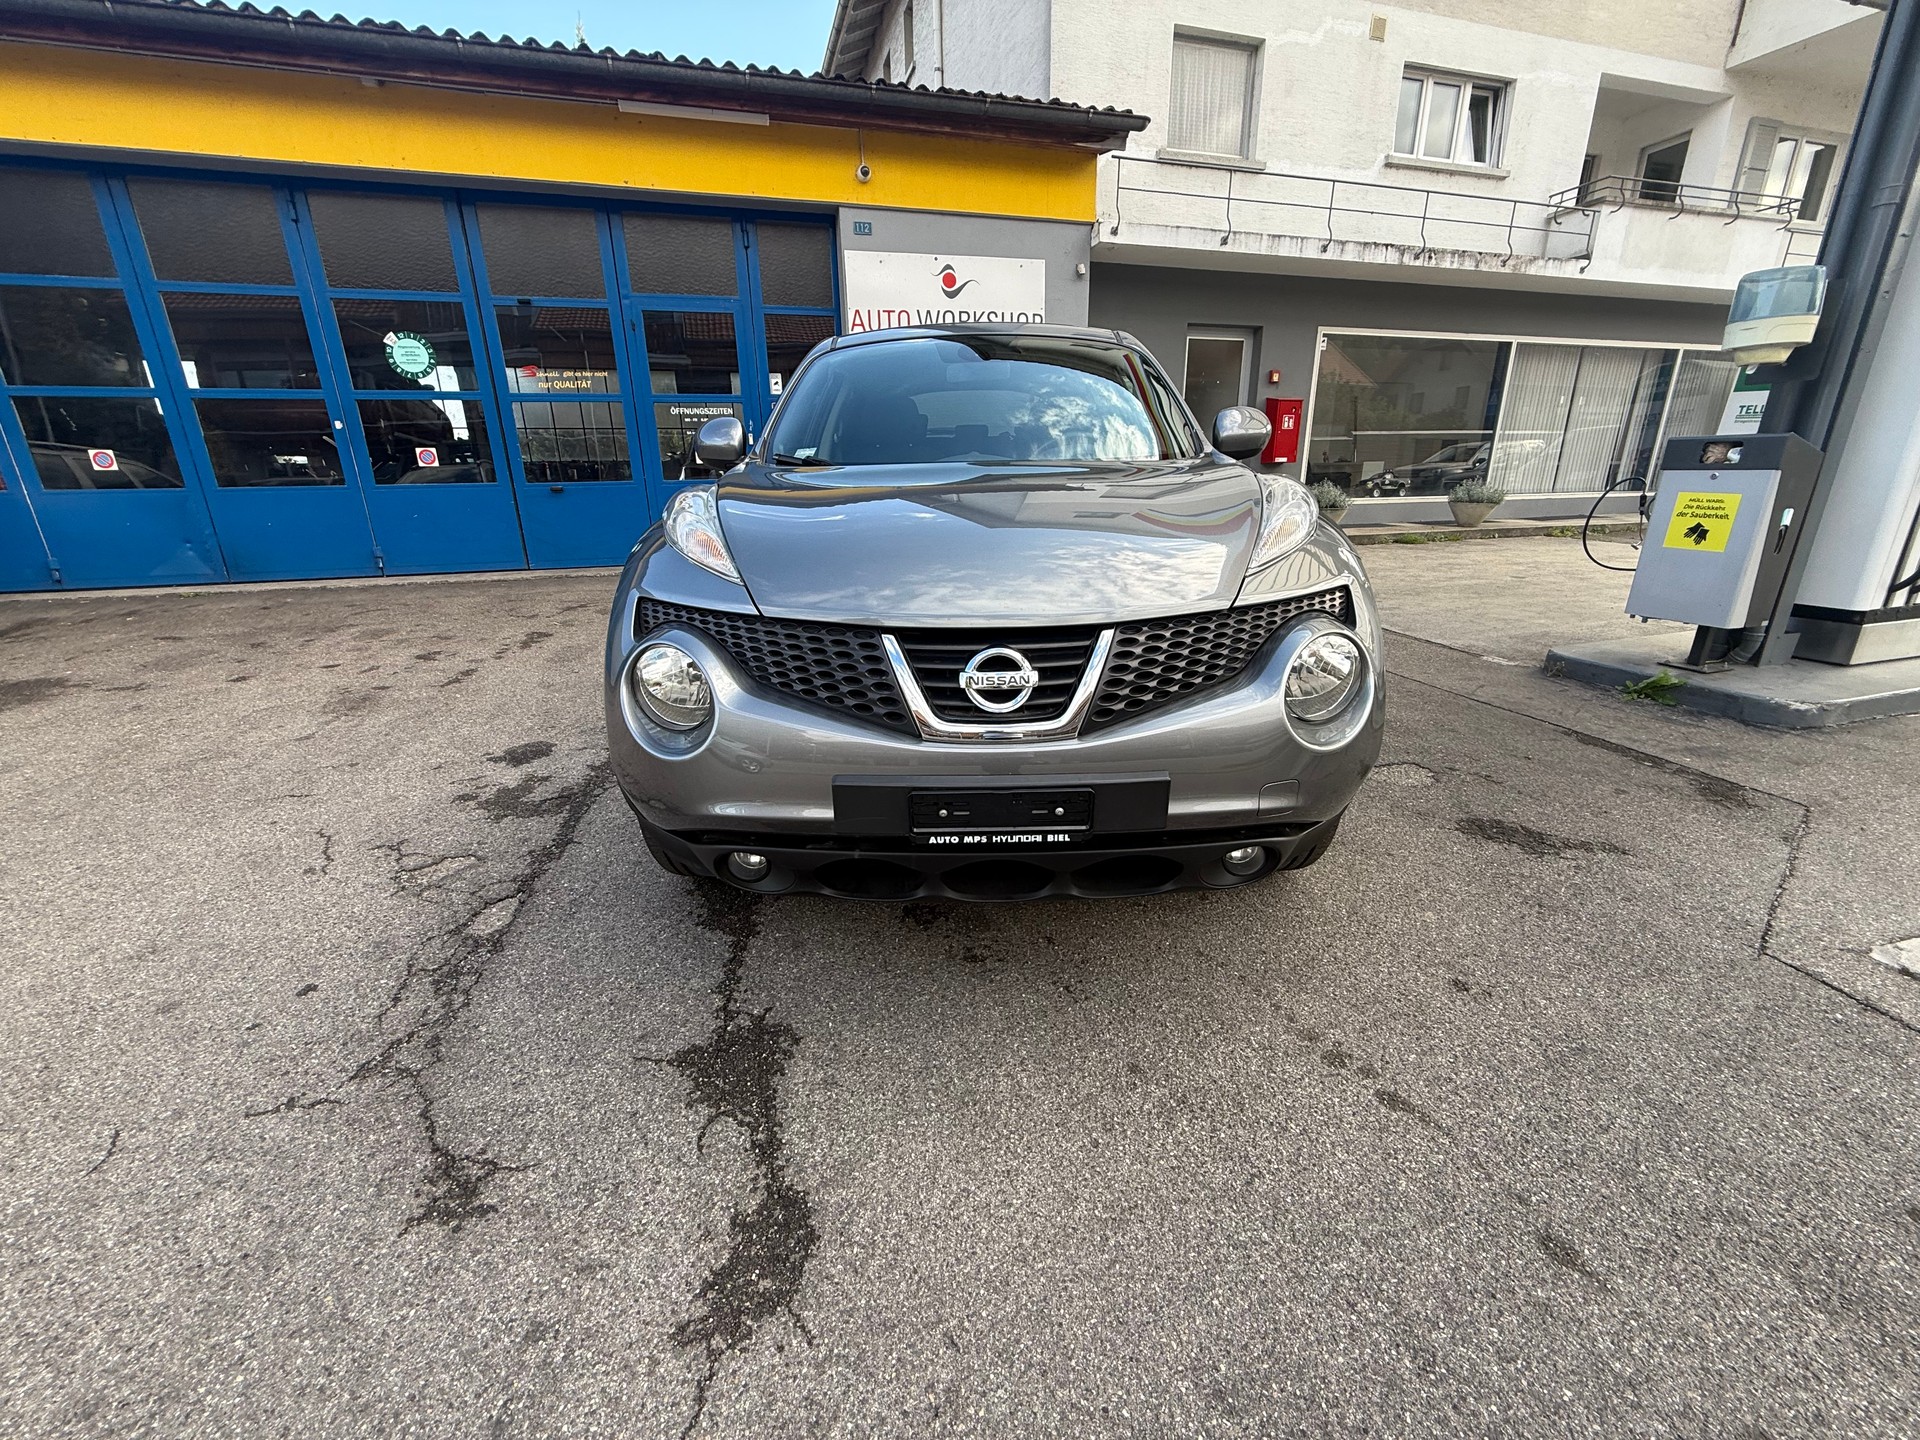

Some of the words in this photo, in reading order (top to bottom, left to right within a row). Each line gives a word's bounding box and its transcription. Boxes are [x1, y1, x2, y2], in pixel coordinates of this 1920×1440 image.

[855, 223, 870, 233] 112
[851, 309, 911, 331] AUTO
[553, 379, 591, 389] QUALITÄT
[670, 406, 733, 415] ÖFFNUNGSZEITEN
[968, 675, 1030, 686] NISSAN
[929, 836, 959, 844] AUTO
[992, 835, 1042, 843] HYUNDAI
[1047, 834, 1070, 842] BIEL
